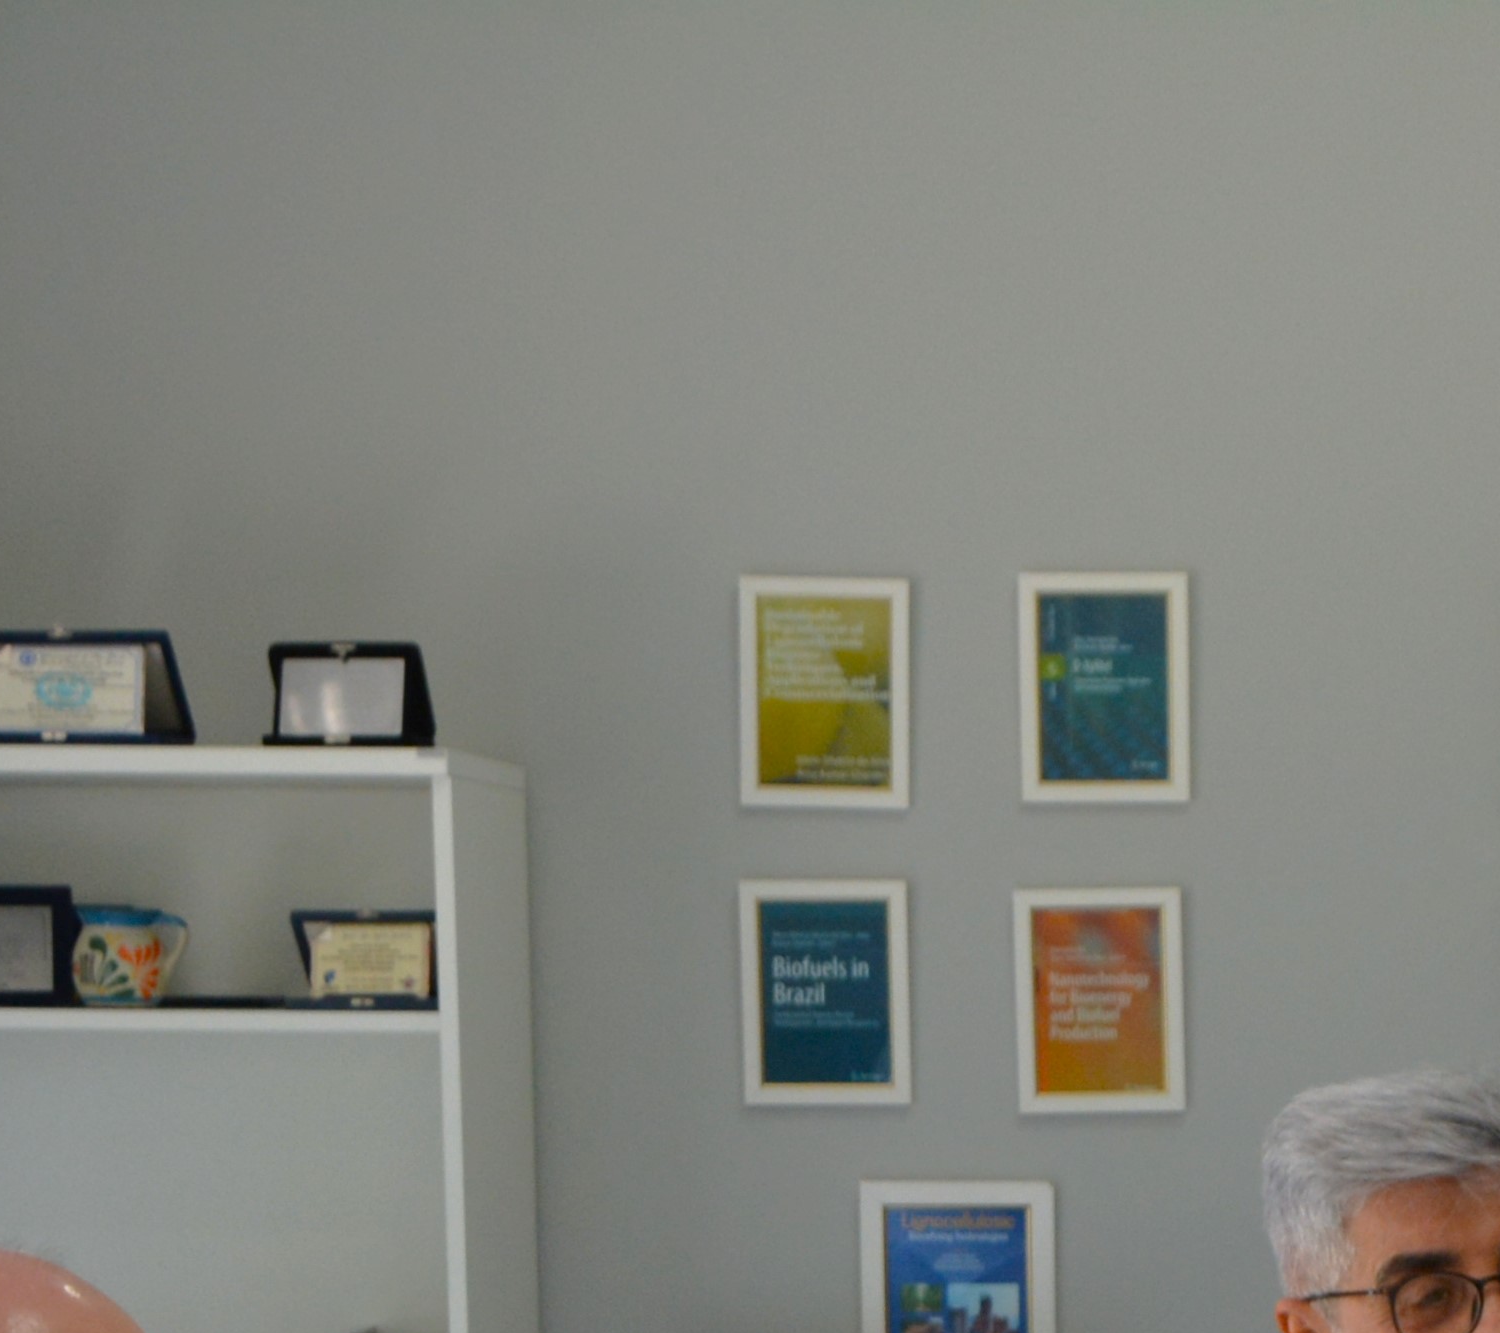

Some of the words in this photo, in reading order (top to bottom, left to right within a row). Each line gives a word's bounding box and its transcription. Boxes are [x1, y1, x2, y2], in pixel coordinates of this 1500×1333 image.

[772, 955, 847, 979] Biofuels
[851, 955, 870, 979] in
[773, 981, 826, 1005] Brazil
[1049, 1007, 1075, 1023] and
[1049, 1024, 1119, 1042] Production
